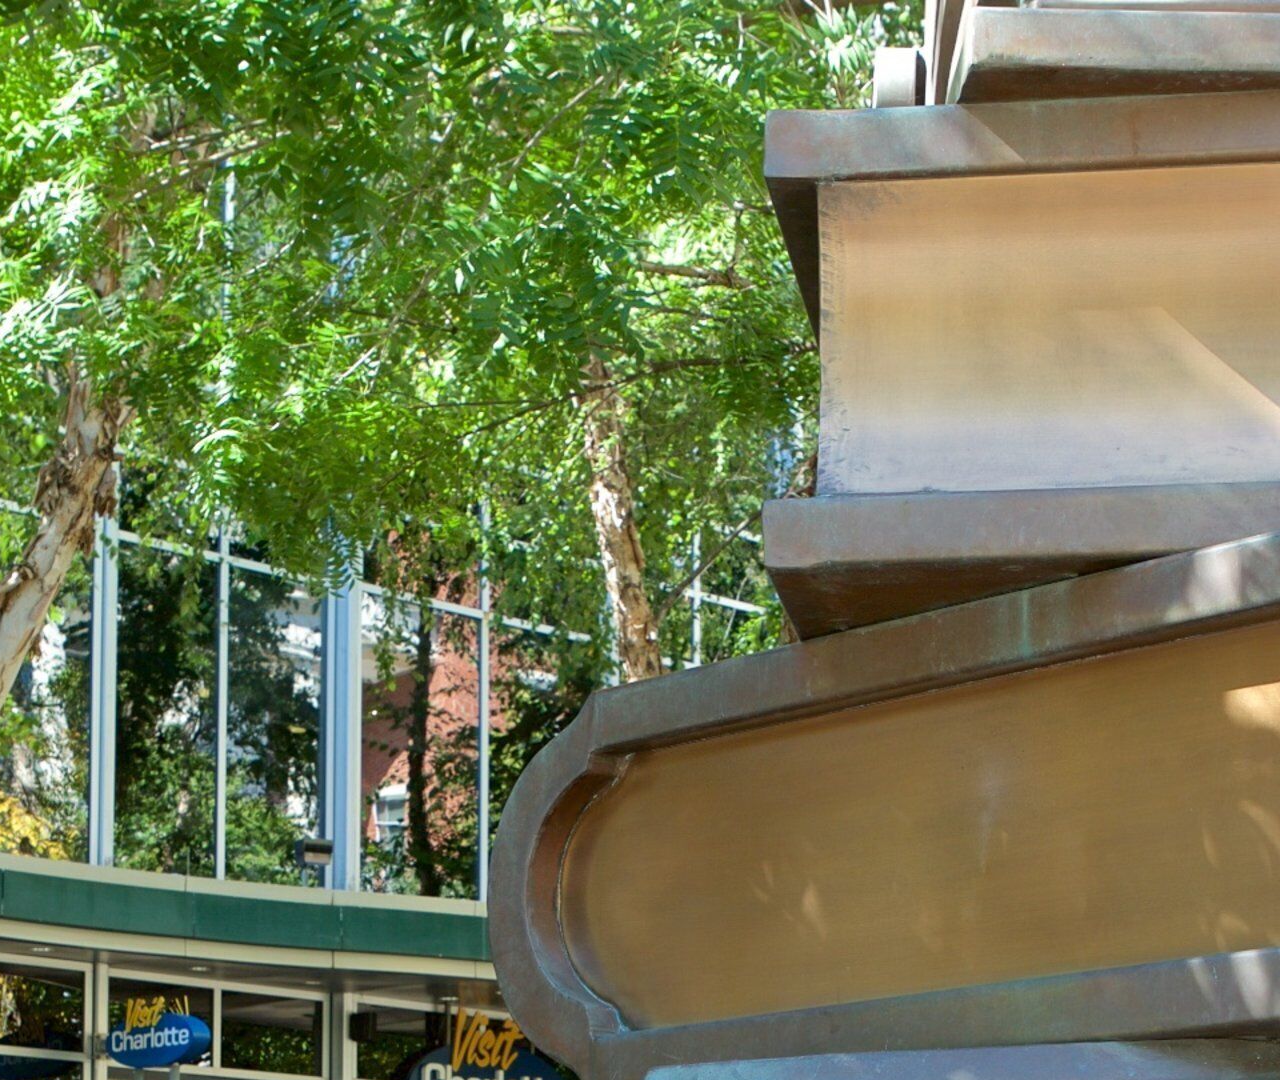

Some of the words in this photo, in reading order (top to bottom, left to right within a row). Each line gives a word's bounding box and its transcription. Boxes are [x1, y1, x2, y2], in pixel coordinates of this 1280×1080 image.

[125, 995, 166, 1033] Visit
[111, 1026, 190, 1053] Charlotte
[452, 1007, 525, 1072] Visit
